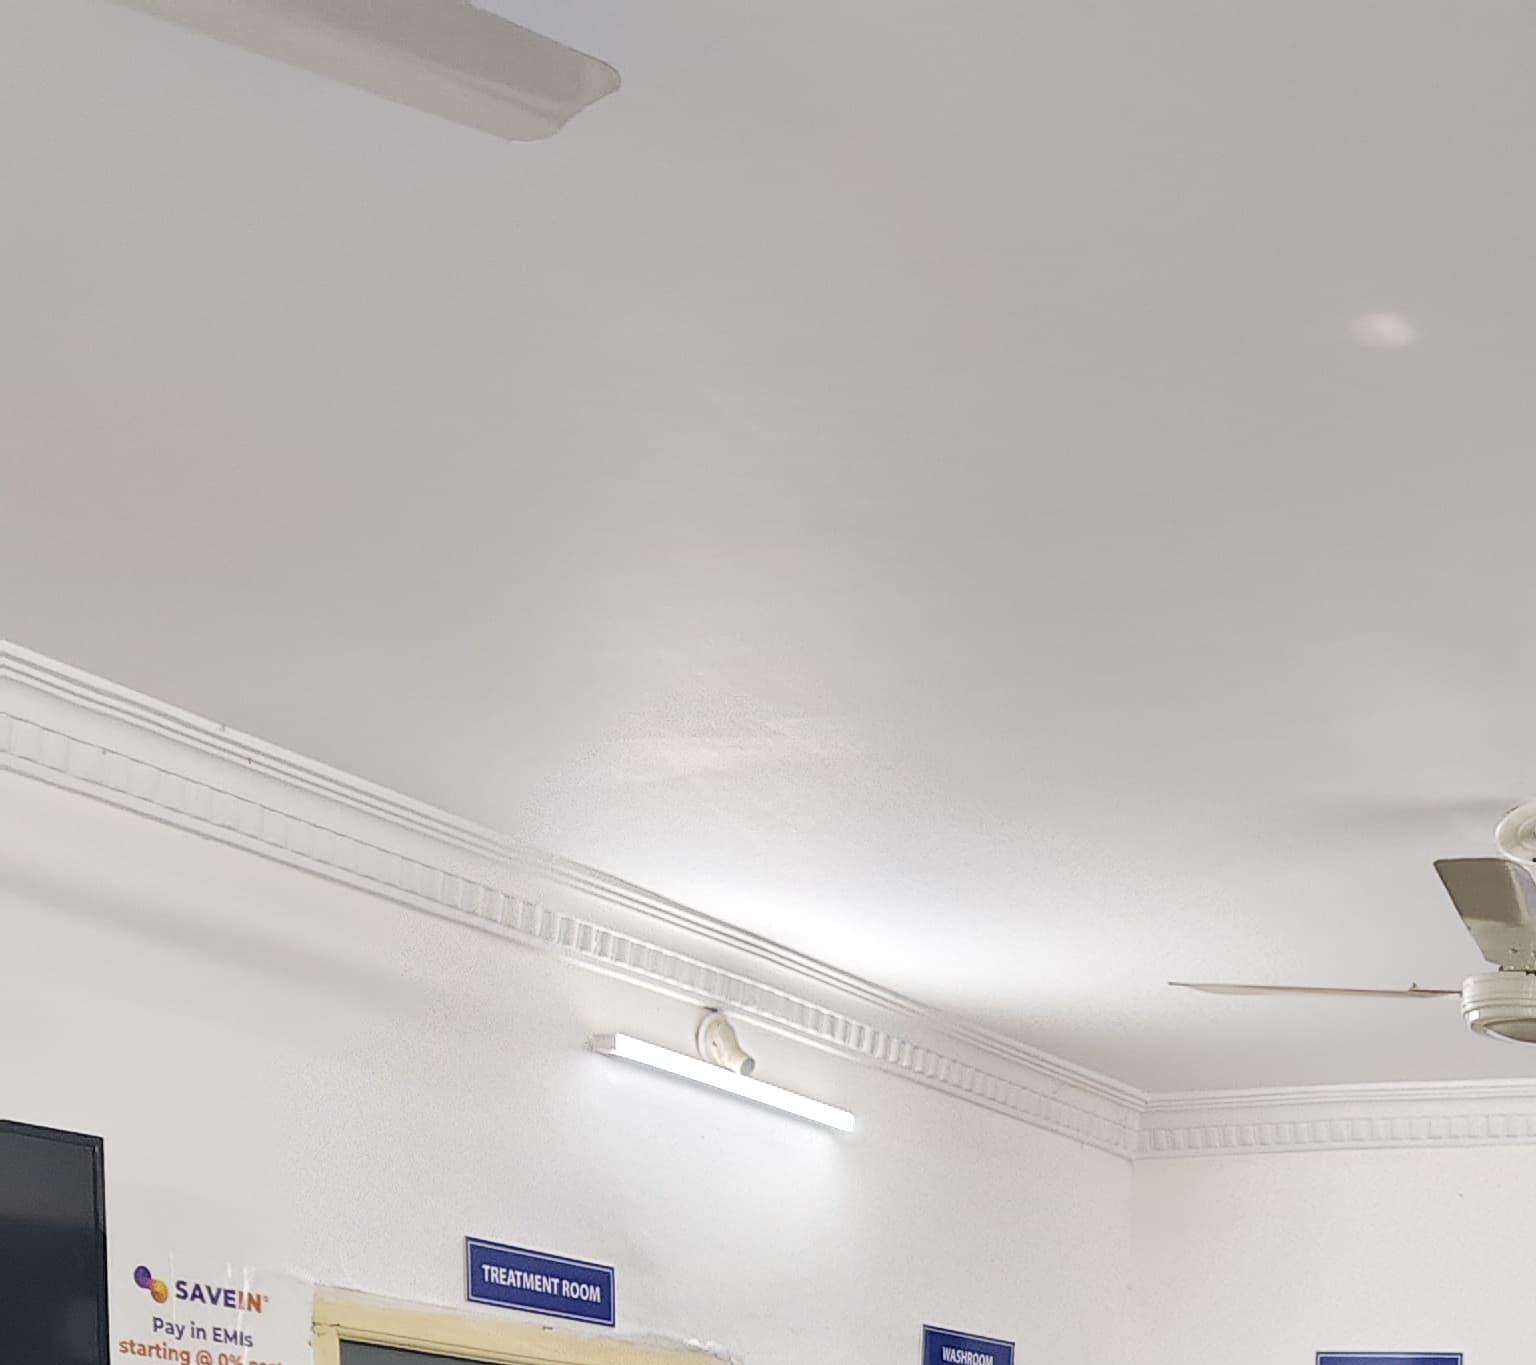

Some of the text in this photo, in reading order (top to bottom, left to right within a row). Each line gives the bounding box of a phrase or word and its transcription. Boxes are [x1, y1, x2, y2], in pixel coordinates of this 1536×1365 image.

[482, 1264, 601, 1303] TREATMENT ROOM
[153, 1316, 253, 1347] Pay in EMIs
[119, 1339, 190, 1365] starting
